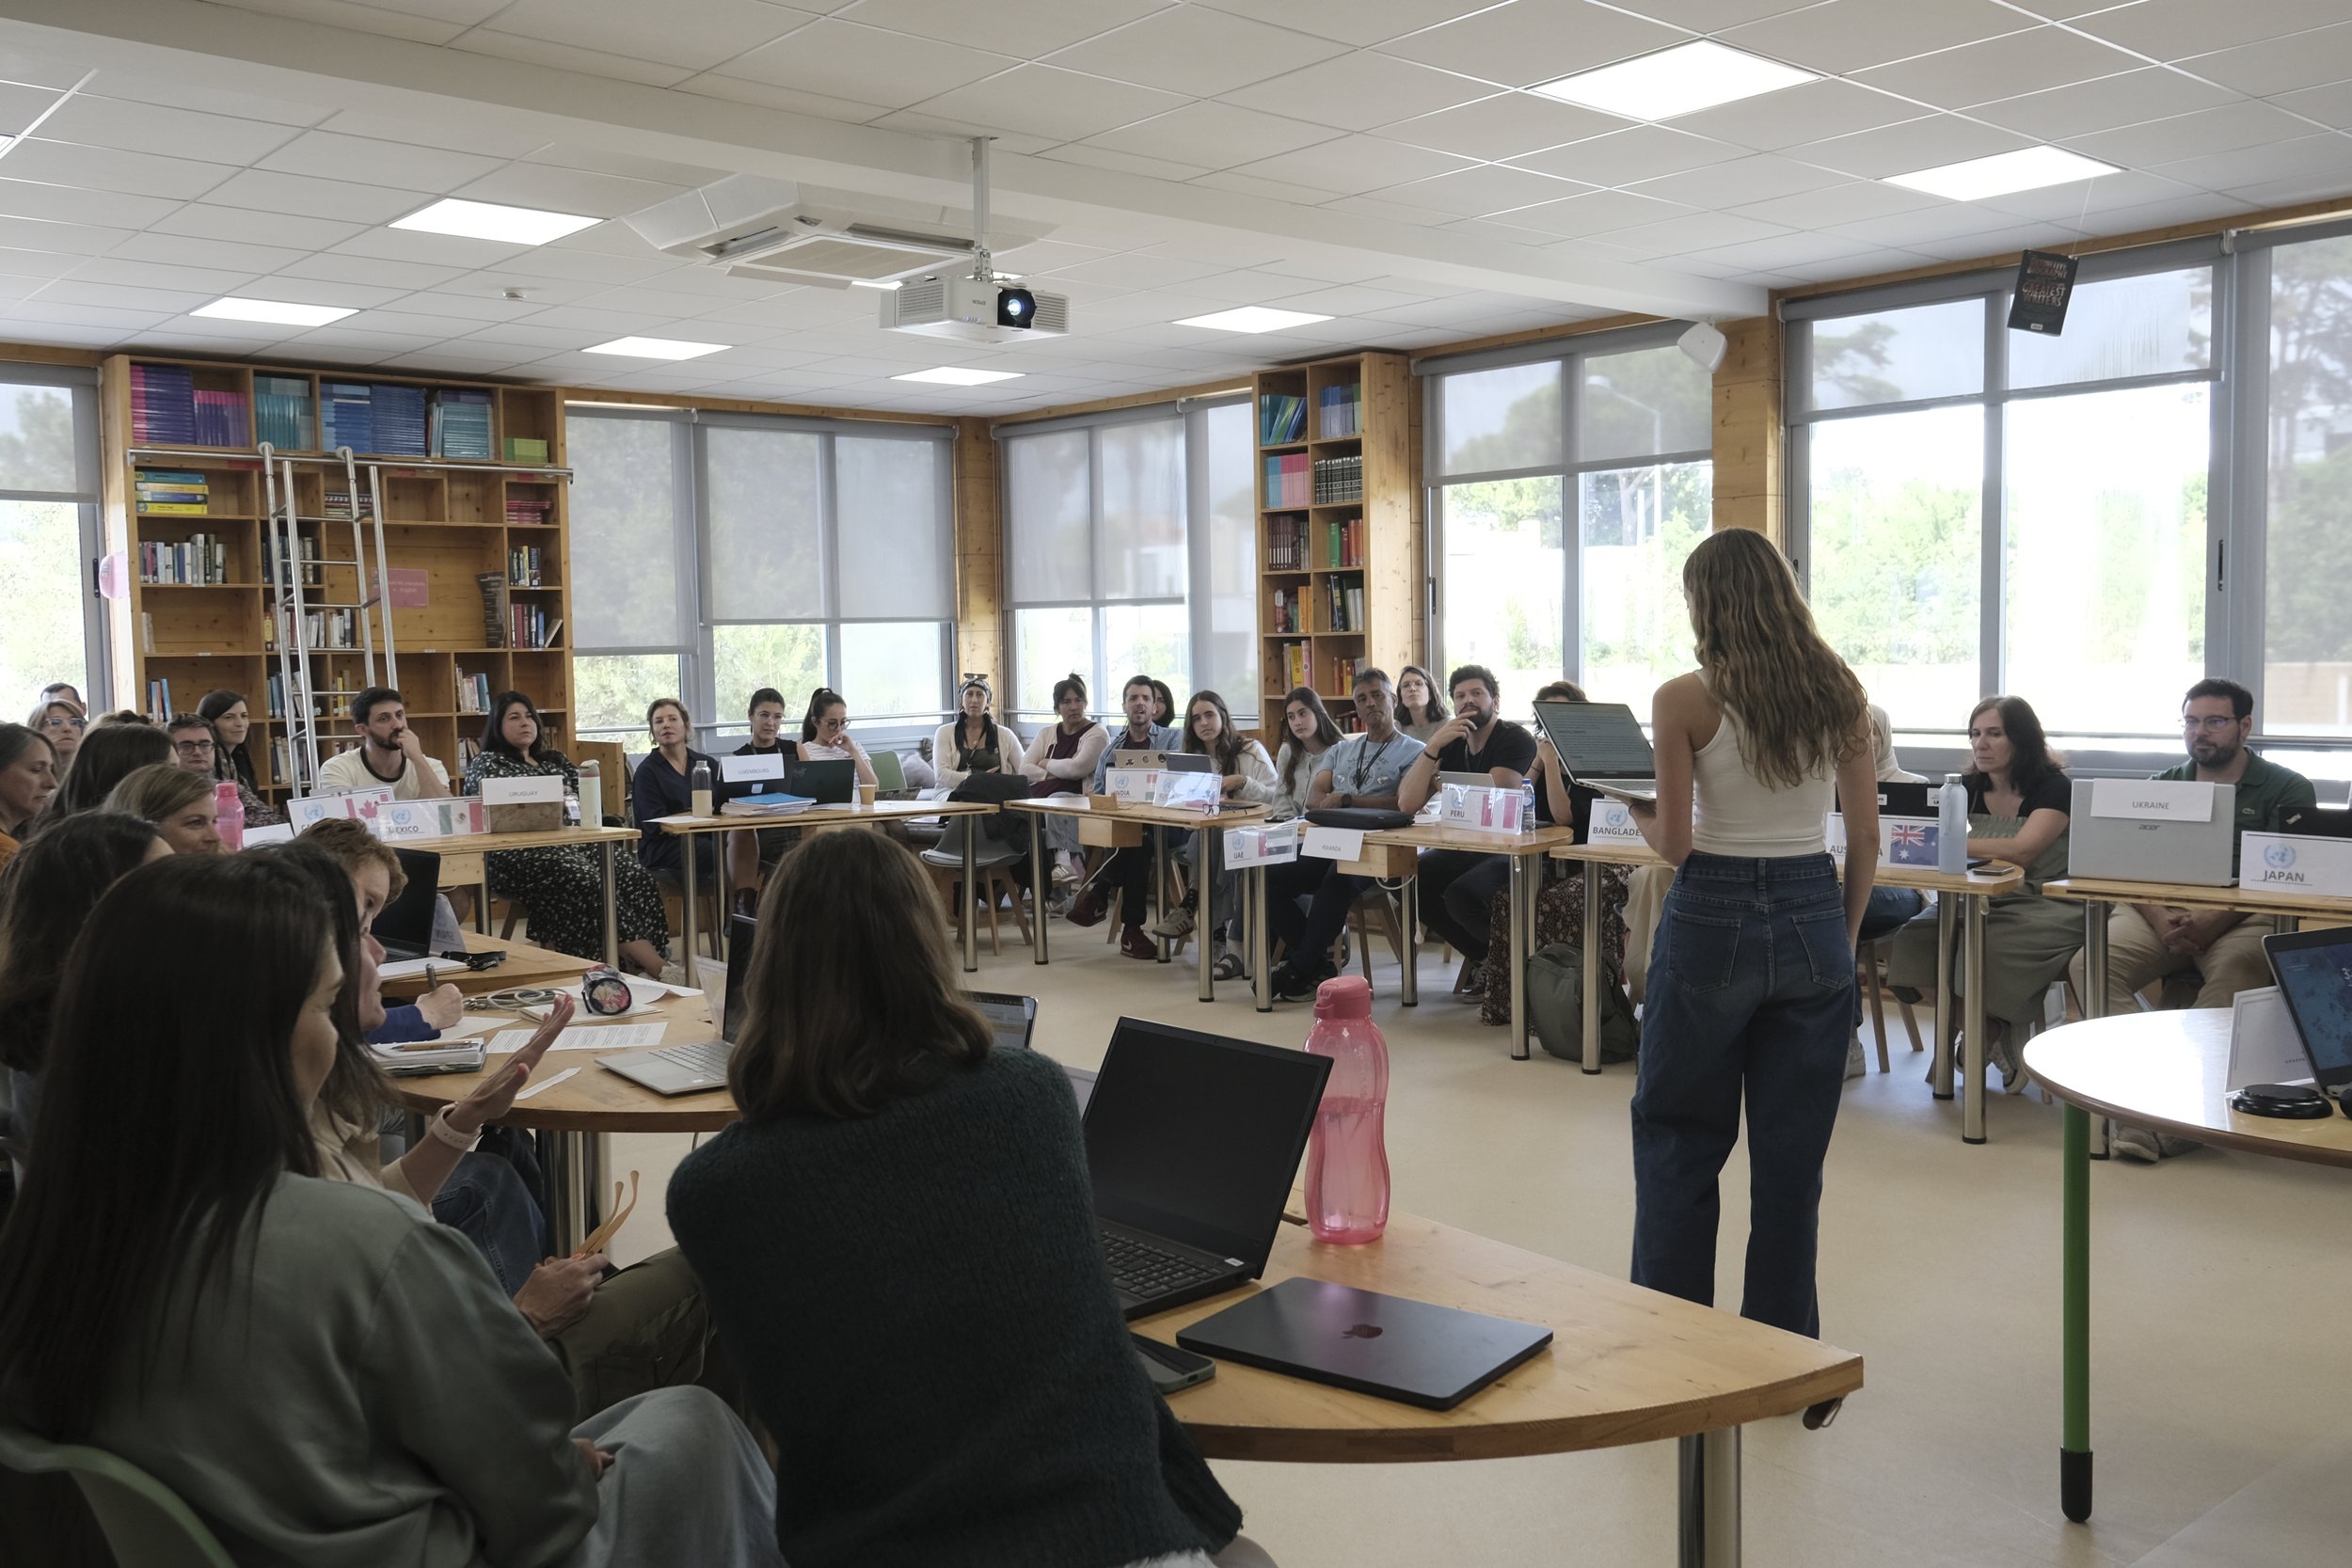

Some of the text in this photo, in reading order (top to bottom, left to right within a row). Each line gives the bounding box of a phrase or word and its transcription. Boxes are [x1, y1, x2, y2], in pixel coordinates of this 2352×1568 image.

[2132, 800, 2169, 810] UKRAINE
[1593, 827, 1641, 836] BANGLADE
[2264, 870, 2304, 882] JAPAN
